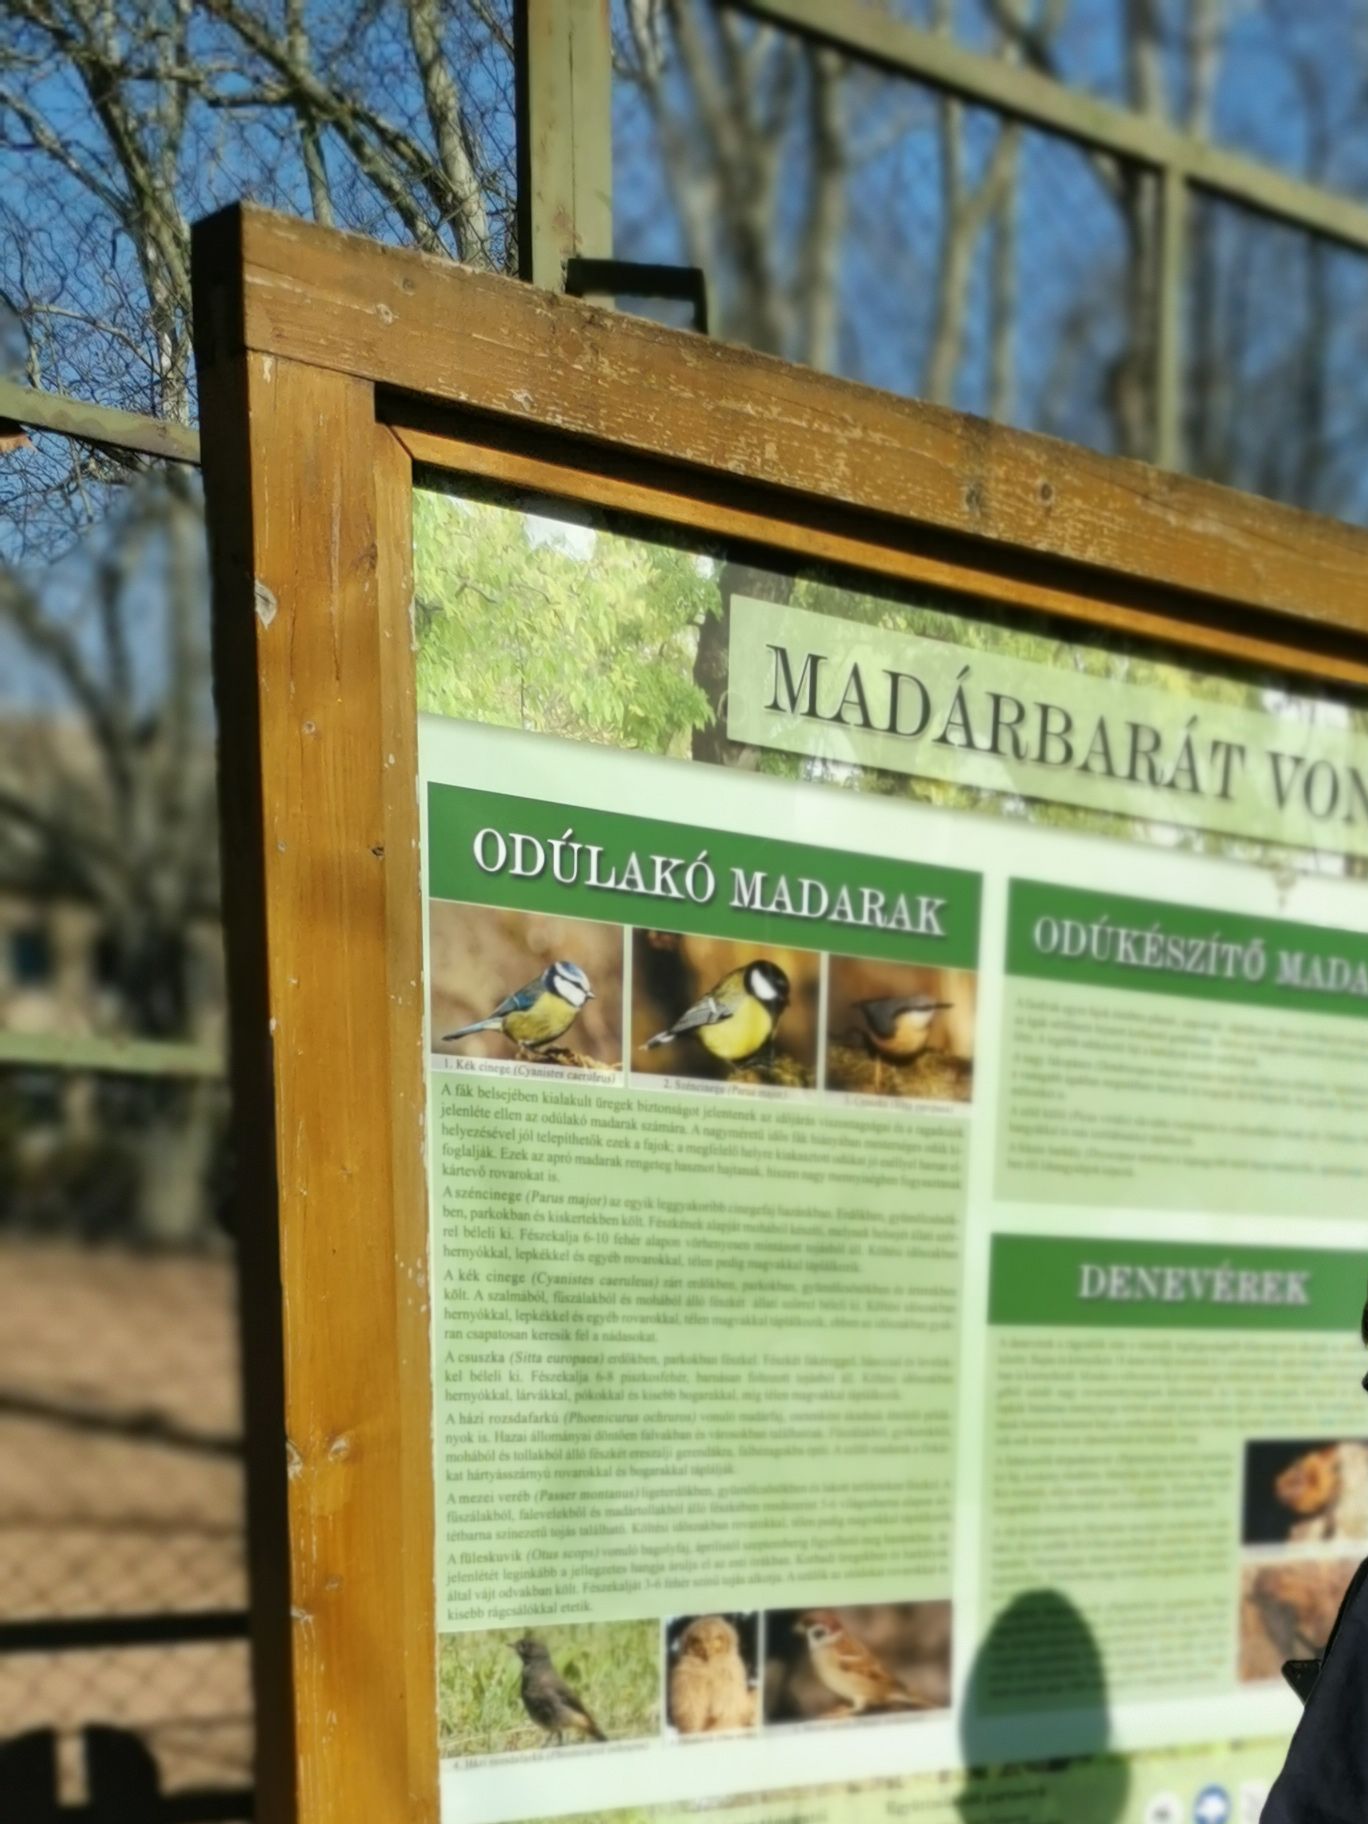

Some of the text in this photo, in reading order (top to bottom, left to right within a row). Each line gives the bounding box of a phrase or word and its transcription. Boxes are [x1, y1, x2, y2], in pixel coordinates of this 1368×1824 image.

[763, 643, 1246, 800] MADÁRBARÁT
[473, 827, 947, 937] ODÚLAKÓ MADARAK
[1034, 914, 1267, 982] ODÚKÉSZÍTŐ
[456, 1060, 476, 1072] Kék
[478, 1061, 512, 1076] cinege
[1078, 1258, 1311, 1306] DENEVÉREK
